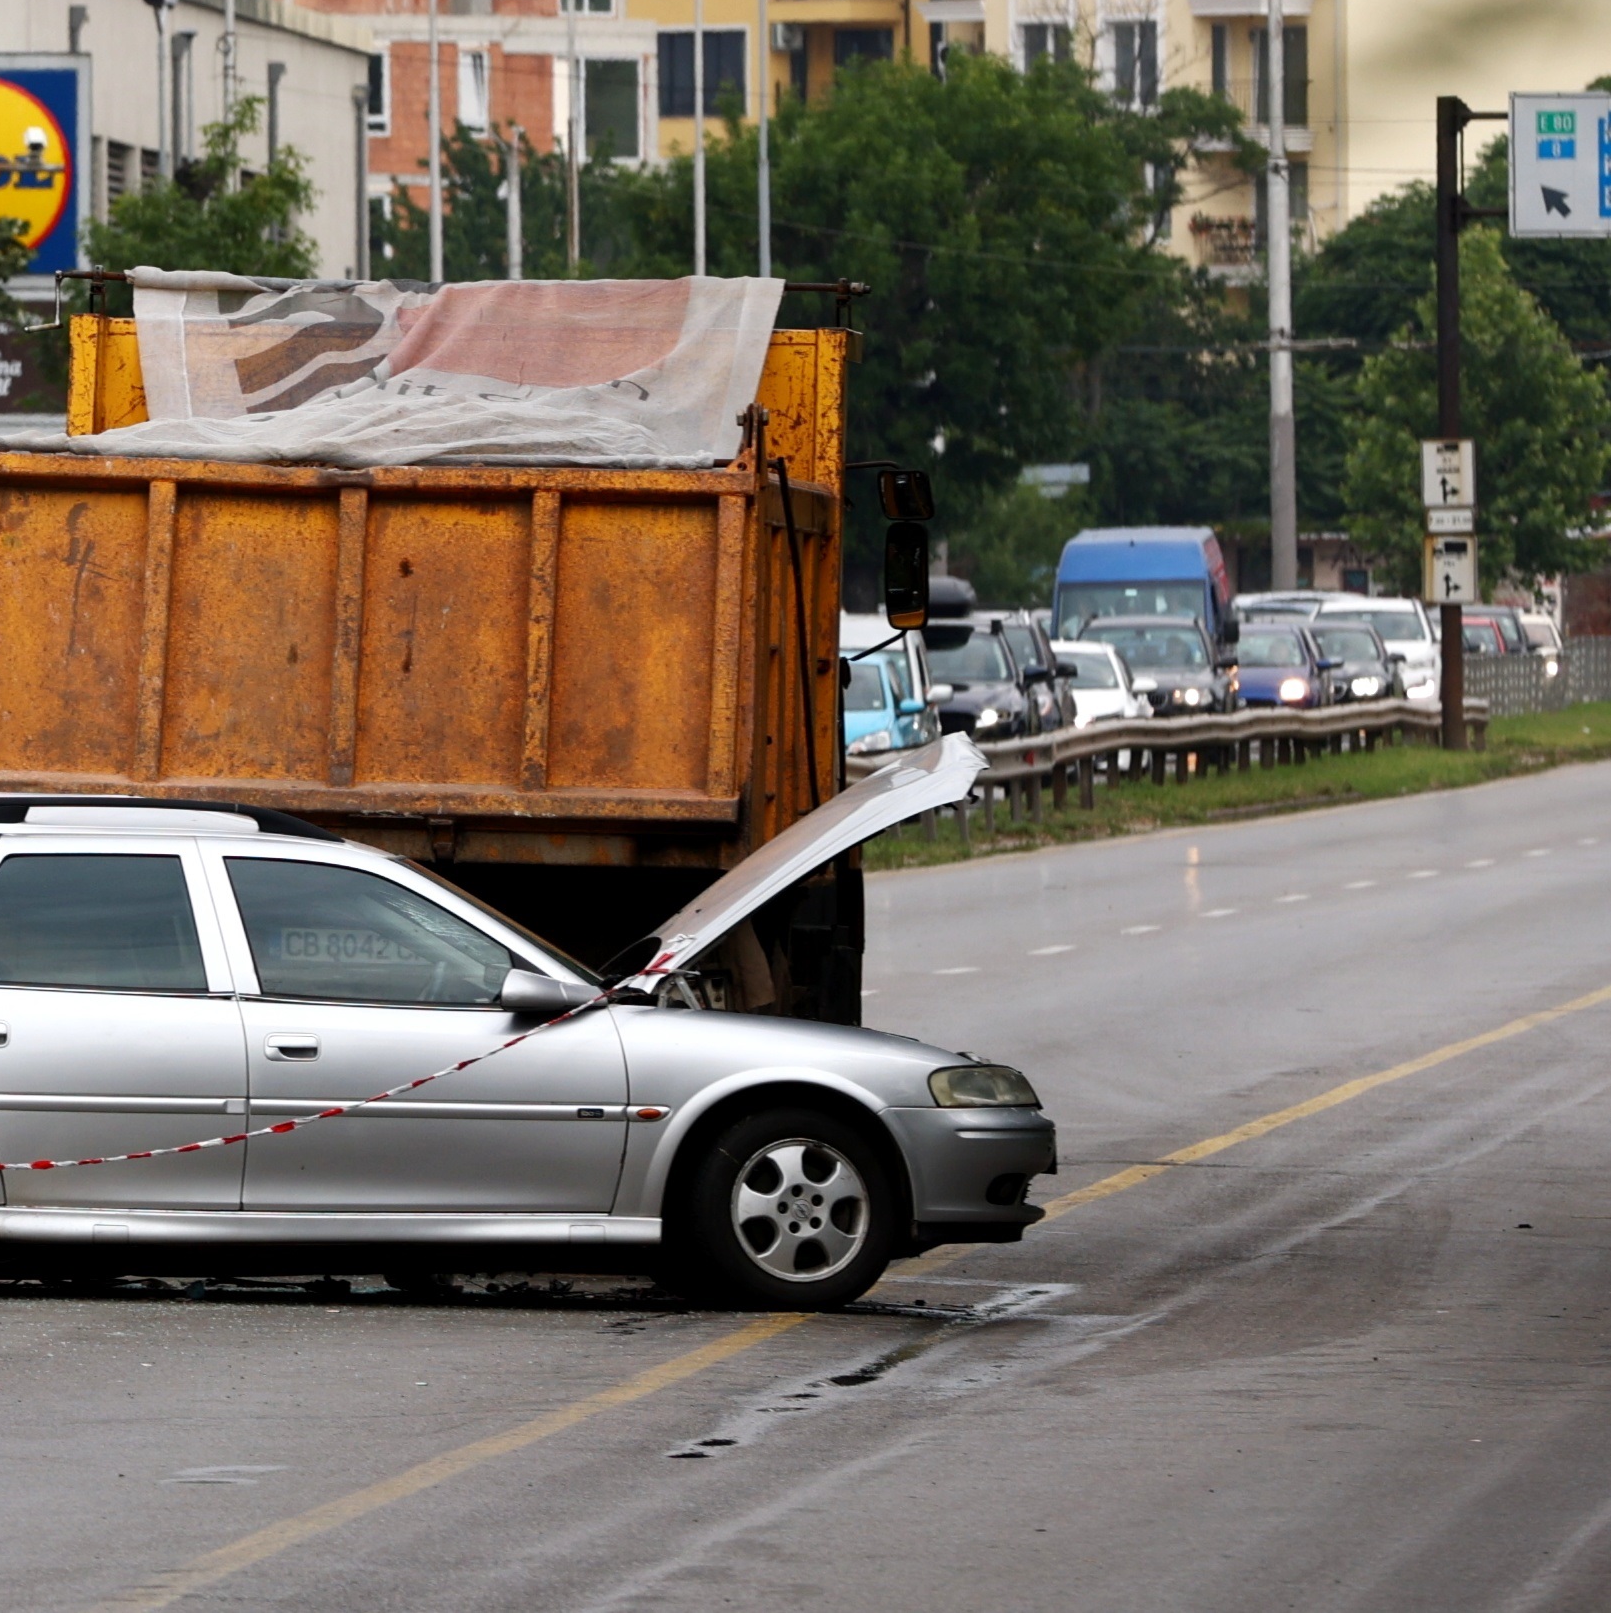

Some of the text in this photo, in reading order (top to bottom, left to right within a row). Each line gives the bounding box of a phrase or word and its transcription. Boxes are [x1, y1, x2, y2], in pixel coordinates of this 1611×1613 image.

[1540, 116, 1572, 132] E 80
[327, 933, 390, 959] 8042
